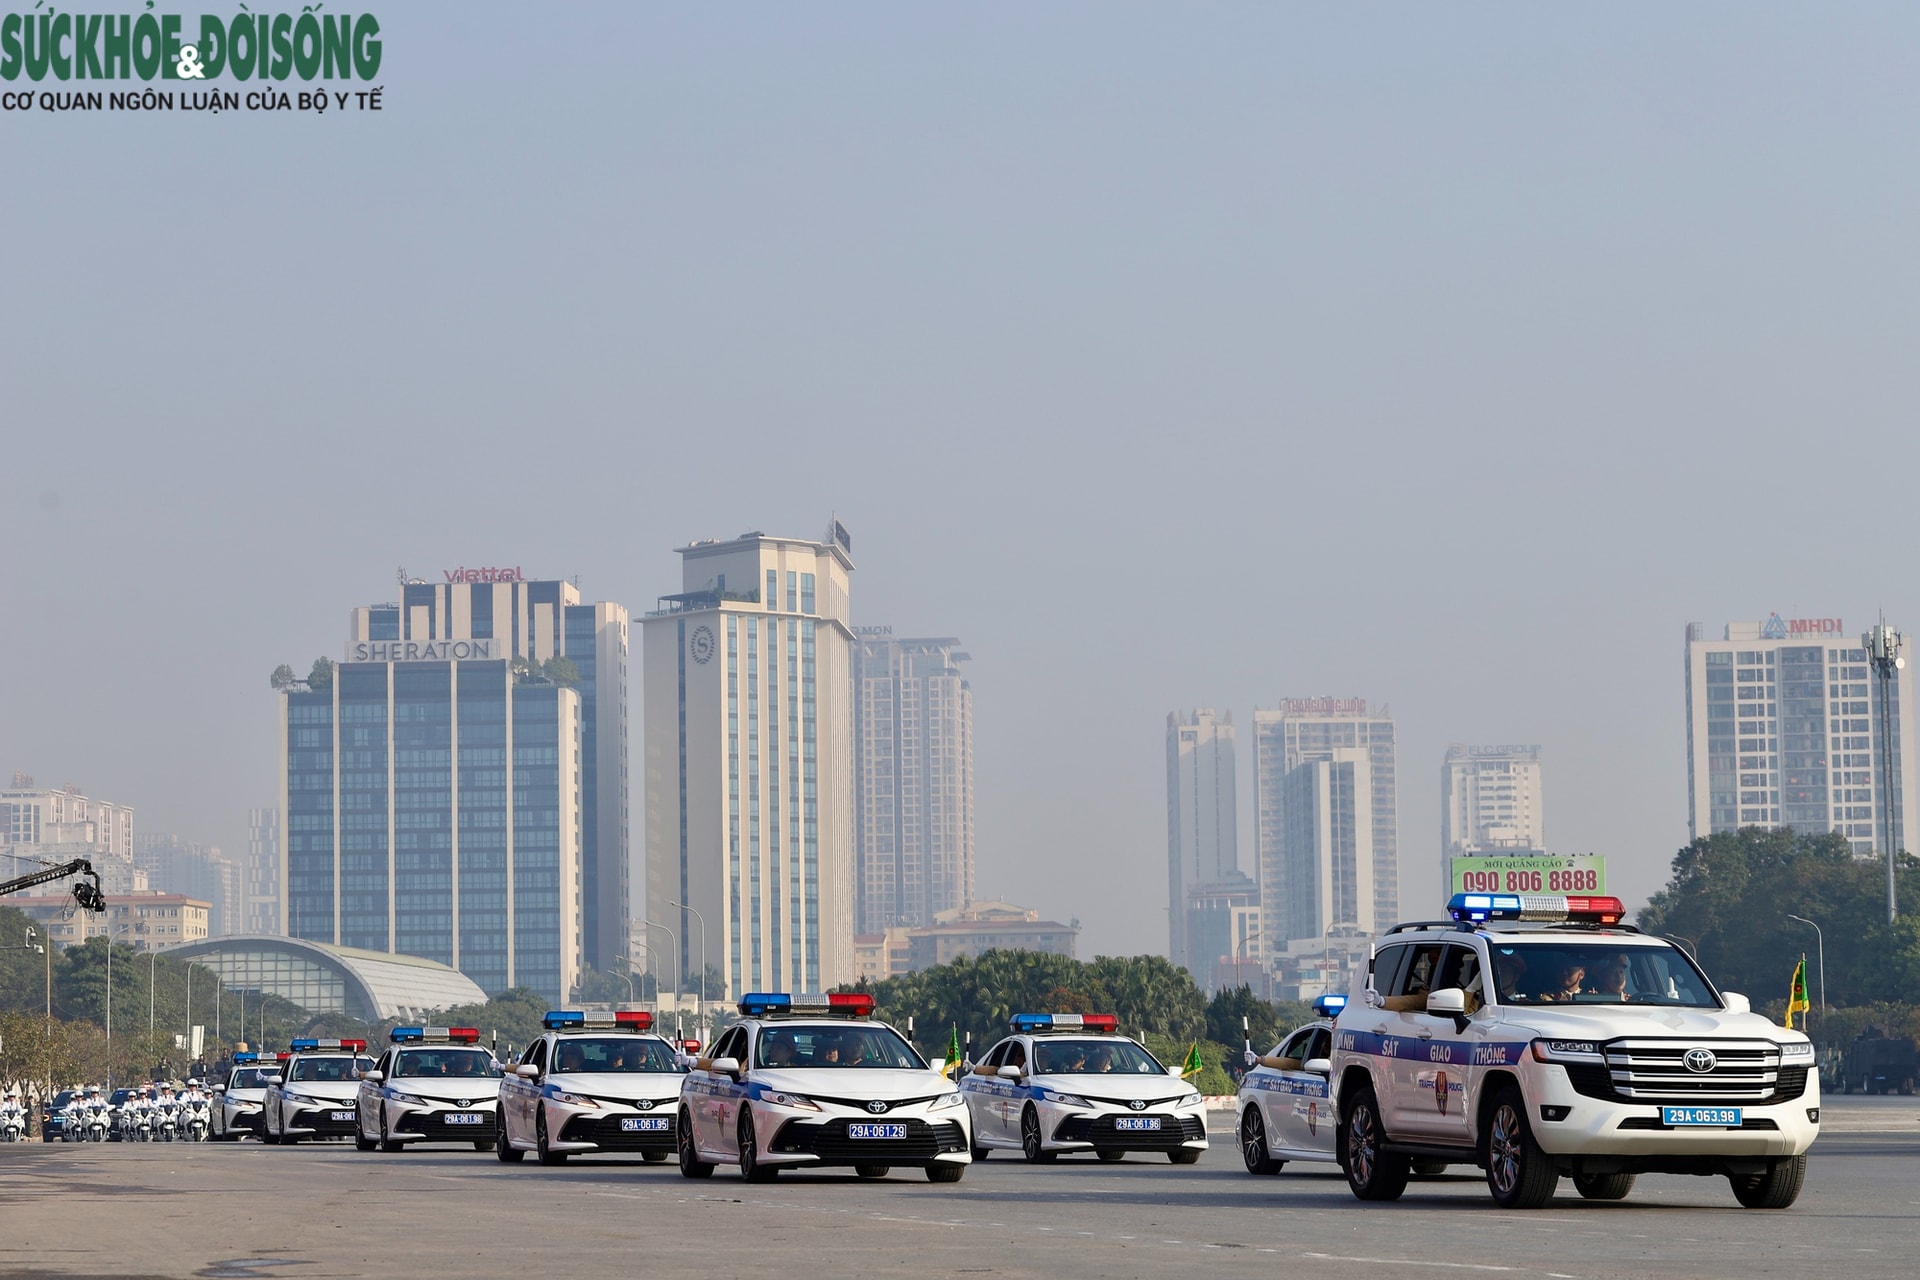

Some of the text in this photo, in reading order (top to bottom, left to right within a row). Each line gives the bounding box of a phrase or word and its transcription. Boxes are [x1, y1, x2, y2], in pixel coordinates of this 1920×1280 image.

[443, 566, 525, 582] viettel
[1790, 618, 1842, 633] MHDI
[356, 641, 489, 661] SHERATON
[1496, 744, 1541, 753] GROUP
[1506, 858, 1540, 869] QUẢNG
[1542, 858, 1562, 868] CÁO
[1463, 870, 1597, 892] 090 806 8888
[1381, 1036, 1399, 1057] SÁT
[1430, 1044, 1451, 1063] GIAO
[1475, 1043, 1506, 1065] THÔNG
[1670, 1109, 1735, 1123] 29A-063.98
[624, 1120, 667, 1129] 29A-061.95
[1117, 1119, 1159, 1129] 29A-061.96
[851, 1126, 904, 1137] 29A-061.29
